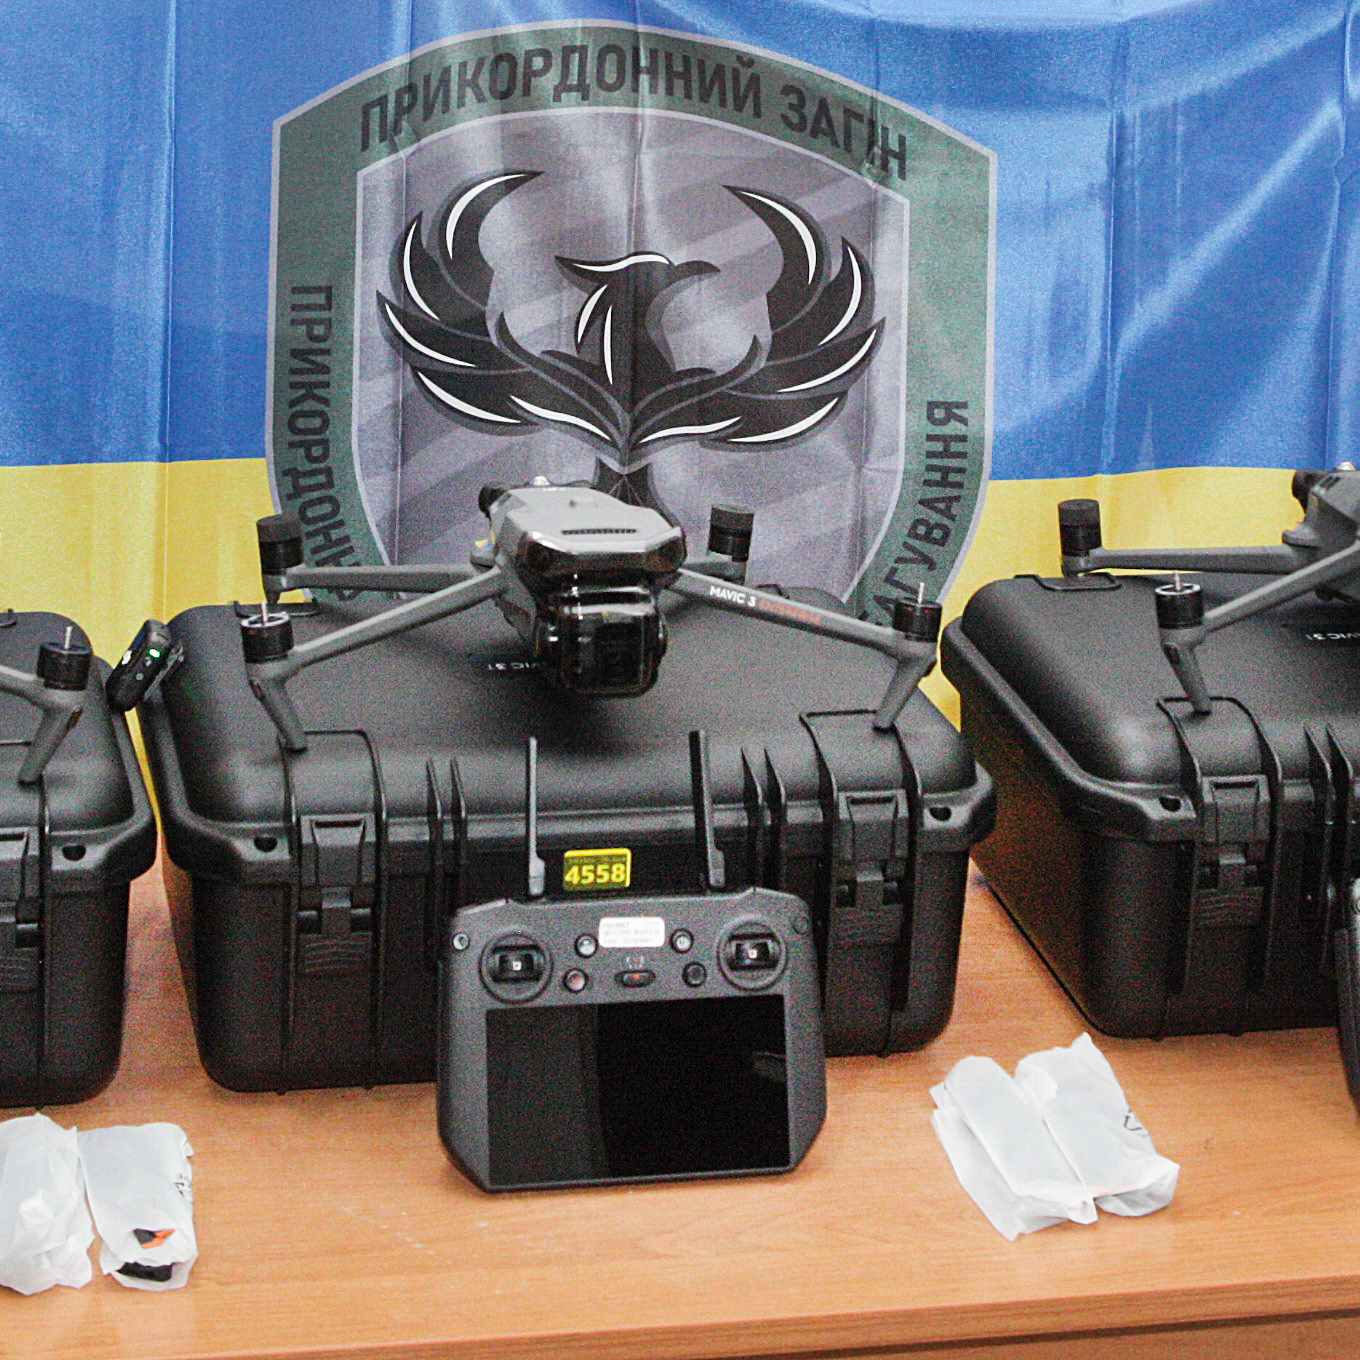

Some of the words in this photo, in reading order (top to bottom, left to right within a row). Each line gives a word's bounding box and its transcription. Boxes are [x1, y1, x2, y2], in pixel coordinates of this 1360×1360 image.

[360, 42, 761, 152] ПРИКОРДОННИЙ
[779, 83, 908, 180] ЗАГІН
[709, 585, 746, 604] MAVIC
[747, 595, 757, 607] 3
[564, 863, 626, 885] 4558
